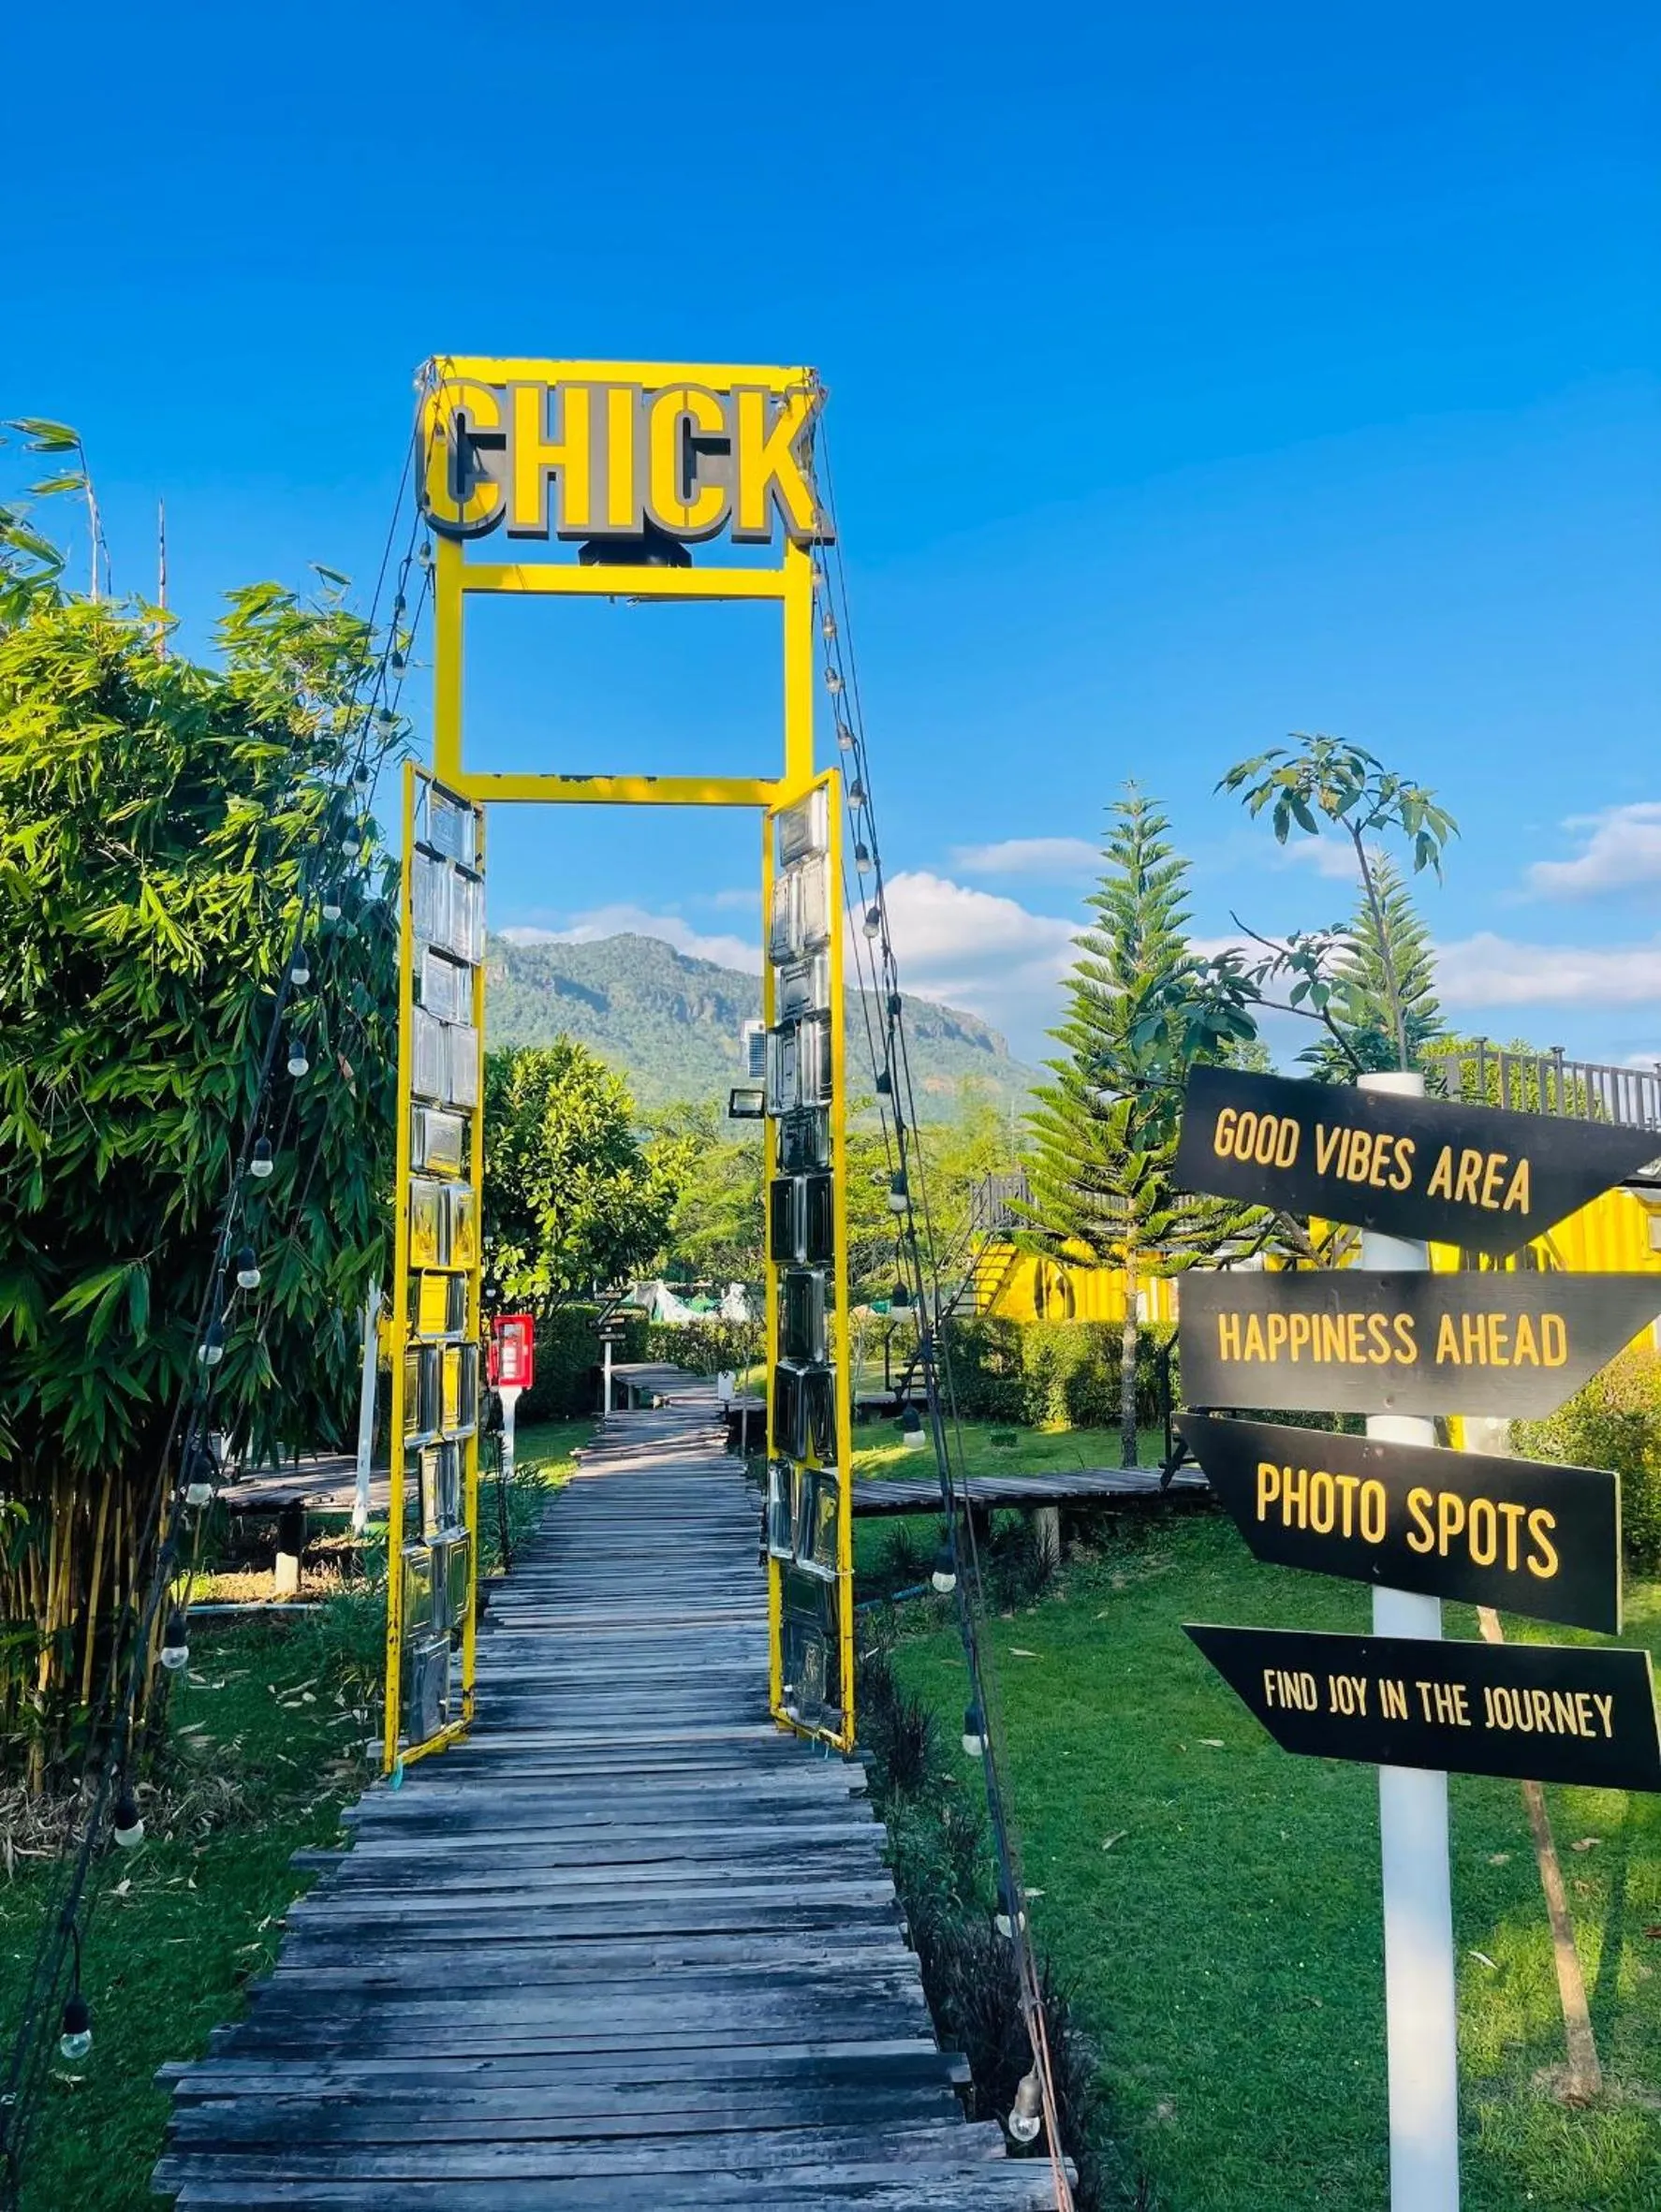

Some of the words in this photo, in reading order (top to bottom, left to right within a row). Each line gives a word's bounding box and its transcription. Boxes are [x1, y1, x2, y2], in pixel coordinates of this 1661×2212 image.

[417, 377, 832, 541] CHICK
[1213, 1107, 1301, 1168] GOOD
[1315, 1123, 1417, 1191] VIBES
[1427, 1145, 1530, 1215] AREA
[1218, 1312, 1418, 1365] HAPPINESS
[1435, 1313, 1568, 1367] AHEAD
[1257, 1462, 1387, 1544] PHOTO
[1406, 1487, 1559, 1579] SPOTS
[1263, 1669, 1317, 1711] FIND
[1328, 1674, 1367, 1716] JOY
[1378, 1678, 1408, 1721] IN
[1416, 1681, 1472, 1727] THE
[1485, 1687, 1614, 1738] JOURNEY
